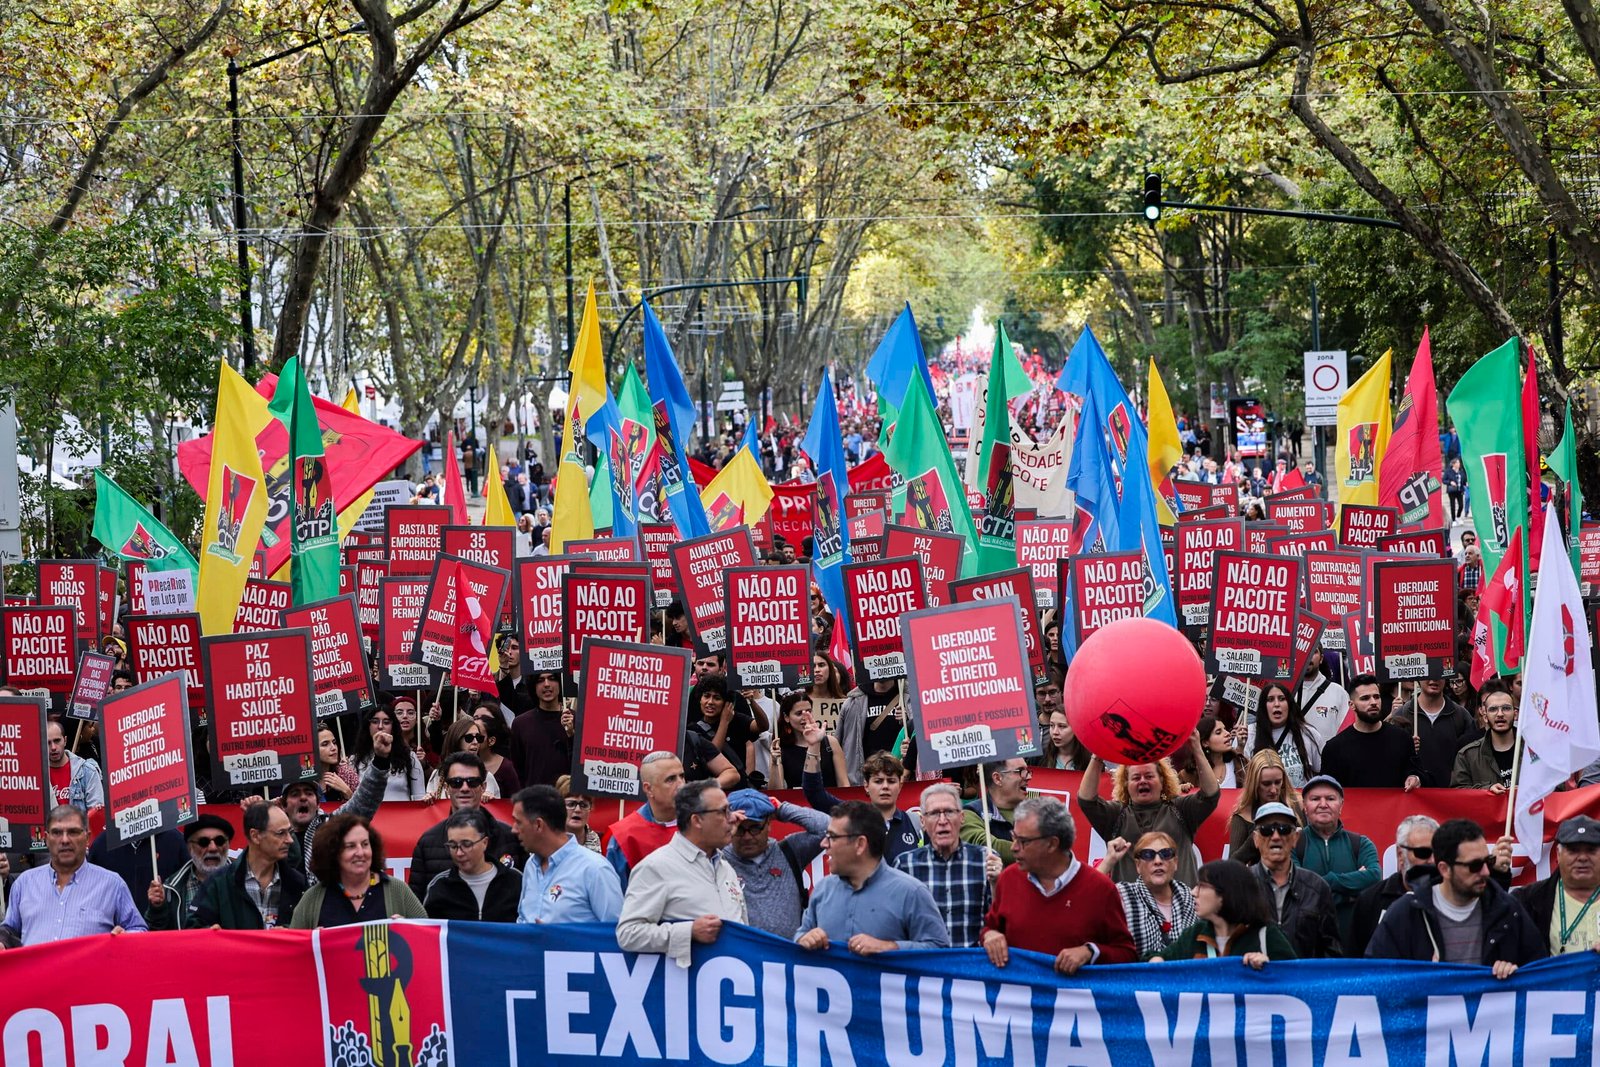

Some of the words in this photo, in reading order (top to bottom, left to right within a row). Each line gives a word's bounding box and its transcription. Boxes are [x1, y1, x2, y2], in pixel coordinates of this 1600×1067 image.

[1212, 487, 1232, 497] MENTO
[853, 498, 876, 508] DIREITO
[1276, 506, 1315, 518] AUMENTO
[1350, 510, 1372, 527] NÃO
[1374, 513, 1388, 528] AO
[399, 524, 426, 535] BASTA
[428, 524, 438, 534] DE
[854, 520, 866, 529] PAZ
[1288, 520, 1304, 530] DAS
[391, 536, 440, 548] EMPOBRECE
[470, 532, 486, 548] 35
[1022, 526, 1048, 544] NÃO
[1052, 528, 1068, 543] AO
[1186, 528, 1212, 549] NÃO
[1216, 528, 1234, 546] AO
[1250, 532, 1266, 542] PAZ
[688, 538, 734, 560] AUMENTO
[852, 543, 878, 554] MENTO
[914, 536, 932, 552] PAZ
[1022, 544, 1070, 561] PACOTE
[1250, 542, 1266, 554] PÃO
[390, 550, 396, 560] A
[458, 549, 499, 566] HORAS
[690, 558, 721, 575] GERAL
[721, 551, 741, 567] DOS
[60, 566, 74, 580] 35
[656, 568, 672, 578] NÃO!
[1084, 560, 1116, 584] NÃO
[1120, 560, 1142, 581] AO
[1226, 560, 1261, 586] NÃO
[1264, 566, 1288, 588] AO
[1310, 561, 1360, 574] CONTRATAÇÃO
[148, 577, 186, 592] PRecáRios
[738, 574, 772, 599] NÃO
[775, 576, 797, 598] AO
[855, 569, 888, 594] NÃO
[891, 568, 912, 590] AO
[1310, 573, 1346, 586] COLETIVA,
[1393, 580, 1439, 594] LIBERDADE
[50, 582, 85, 595] HORAS
[240, 585, 267, 606] NÃO
[269, 591, 288, 608] AO
[399, 585, 412, 596] UM
[576, 582, 610, 607] NÃO
[614, 586, 636, 608] AO
[1085, 584, 1144, 606] PACOTE
[150, 596, 160, 606] em
[162, 592, 176, 605] Luta
[176, 593, 188, 605] por
[392, 596, 403, 607] DE
[858, 591, 918, 618] PACOTE
[1224, 587, 1288, 612] PACOTE
[1315, 592, 1360, 605] CADUCIDADE,
[1398, 594, 1436, 607] SINDICAL
[310, 608, 328, 623] PAZ
[738, 600, 800, 622] PACOTE
[1330, 604, 1348, 615] NÃO!
[1397, 608, 1403, 620] É
[1404, 607, 1436, 620] DIREITO
[12, 614, 42, 634] NÃO
[46, 616, 65, 633] AO
[576, 610, 637, 632] PACOTE
[1216, 610, 1290, 637] LABORAL
[1382, 620, 1451, 634] CONSTITUCIONAL
[137, 623, 167, 646] NÃO
[171, 624, 190, 644] AO
[313, 622, 331, 638] PÃO
[733, 624, 806, 647] LABORAL
[930, 626, 997, 650] LIBERDADE
[12, 636, 66, 655] PACOTE
[312, 632, 349, 653] BITAÇÃO
[139, 646, 195, 668] PACOTE
[246, 643, 270, 660] PAZ
[312, 649, 342, 666] SAÚDE
[939, 645, 994, 666] SINDICAL
[1226, 650, 1254, 662] SALÁRIO
[8, 656, 73, 676] LABORAL
[86, 658, 110, 671] AUMENTO
[246, 660, 272, 679] PÃO
[609, 652, 626, 668] UM
[628, 656, 663, 672] POSTO
[748, 664, 775, 674] SALÁRIO
[873, 656, 899, 668] SALÁRIO
[1228, 662, 1258, 672] DIREITOS
[1394, 656, 1421, 666] SALÁRIO
[90, 669, 102, 678] DAS
[398, 666, 422, 675] SALÁRIO
[598, 667, 612, 682] DE
[614, 669, 671, 690] TRABALHO
[750, 674, 780, 684] DIREITOS
[878, 666, 905, 676] DIREITOS
[940, 667, 948, 684] É
[951, 662, 998, 683] DIREITO
[1398, 666, 1425, 676] DIREITOS
[80, 678, 107, 689] REFORMAS
[226, 676, 295, 700] HABITAÇÃO
[400, 676, 427, 684] DIREITOS
[83, 688, 104, 700] PENSÕES
[596, 683, 670, 706] PERMANENTE
[921, 676, 1022, 706] CONSTITUCIONAL
[242, 698, 282, 718] SAÚDE
[318, 702, 344, 715] DIREITOS
[118, 703, 166, 733] LIBERDADE
[231, 715, 296, 738] EDUCAÇÃO
[608, 714, 653, 736] VÍNCULO
[928, 718, 952, 730] OUTRO
[954, 714, 976, 725] RUMO
[978, 712, 983, 722] É
[984, 707, 1024, 722] POSSÍVEL!
[123, 722, 164, 747] SINDICAL
[604, 732, 654, 752] EFECTIVO
[945, 730, 983, 747] SALÁRIO
[124, 748, 130, 764] É
[132, 738, 166, 762] DIREITO
[222, 741, 244, 752] OUTRO
[246, 739, 266, 750] RUMO
[273, 735, 308, 747] POSSÍVEL!
[951, 744, 991, 760] DIREITOS
[237, 755, 271, 768] SALÁRIO
[584, 746, 607, 757] OUTRO
[608, 748, 628, 760] RUMO
[110, 749, 184, 786] CONSTITUCIONAL
[242, 768, 278, 782] DIREITOS
[596, 765, 630, 778] SALÁRIO
[114, 796, 130, 808] OUTRO
[132, 790, 148, 802] RUMO
[154, 778, 184, 795] POSSÍVEL!
[598, 778, 634, 792] DIREITOS
[4, 805, 38, 814] POSSÍVEL!
[125, 804, 152, 823] SALÁRIO
[129, 818, 158, 835] DIREITOS
[543, 949, 858, 1067] EXIGIR
[880, 973, 1112, 1067] UMA
[1135, 990, 1388, 1067] VIDA
[3, 995, 234, 1067] ORAL
